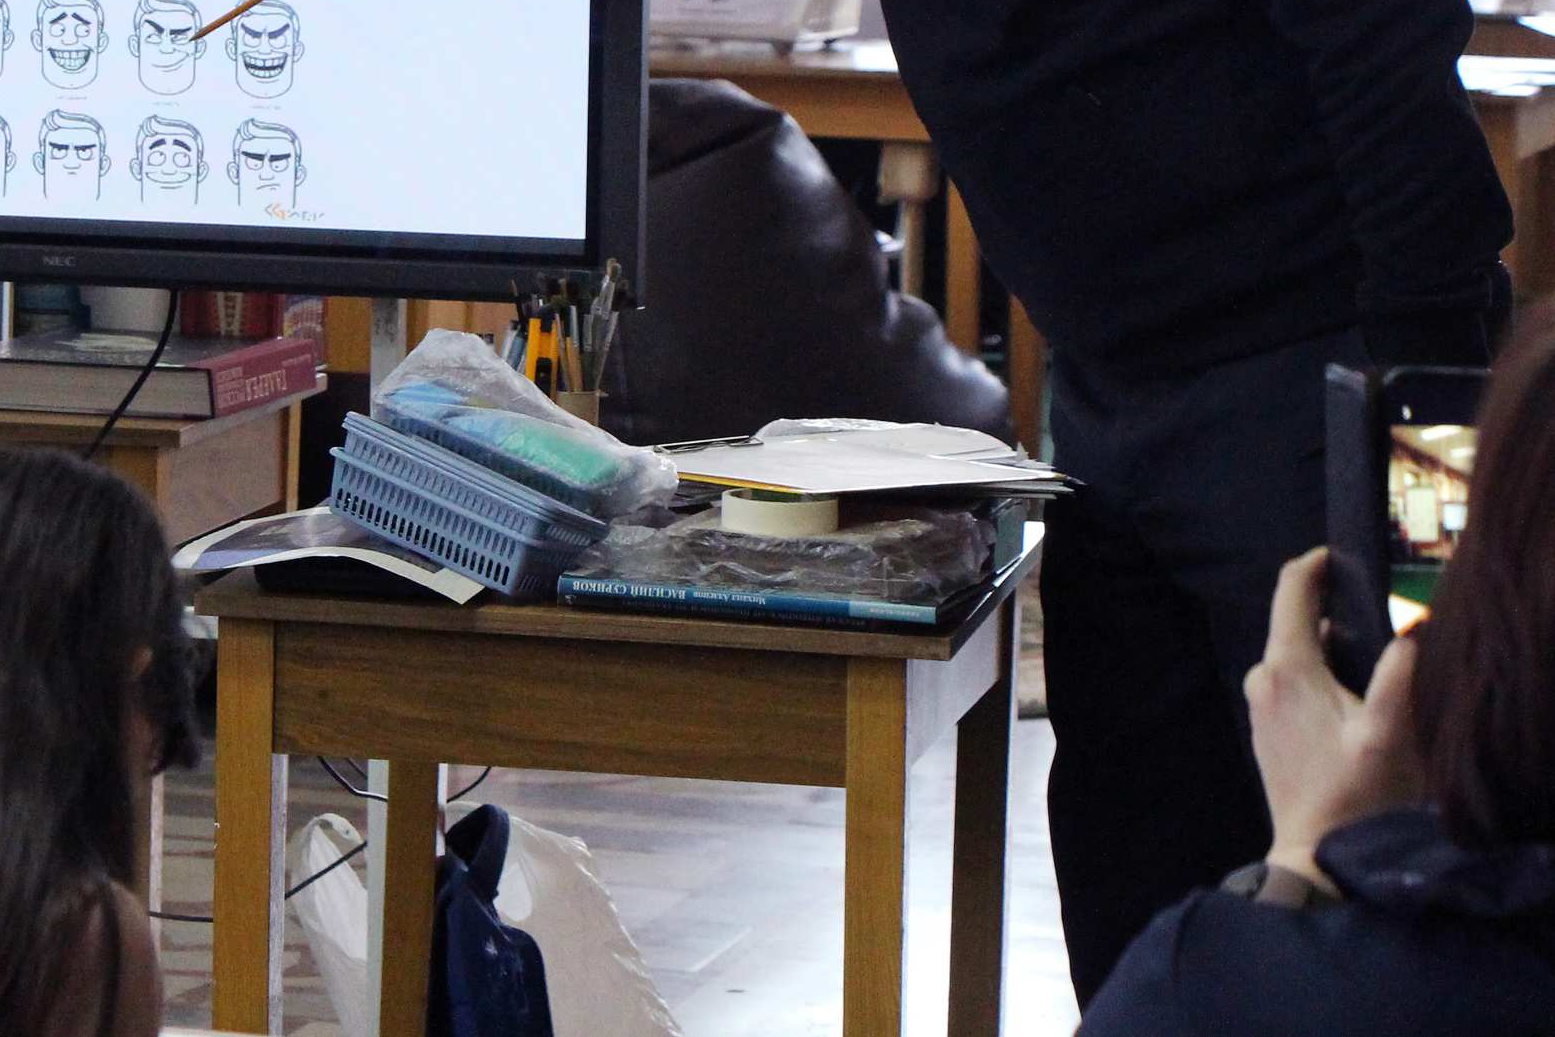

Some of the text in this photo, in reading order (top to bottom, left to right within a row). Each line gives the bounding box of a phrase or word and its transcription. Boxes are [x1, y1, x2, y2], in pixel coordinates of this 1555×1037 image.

[42, 255, 76, 267] NEC
[572, 580, 627, 594] СУРИКОВ
[630, 585, 686, 600] ВАСИЛИЙ
